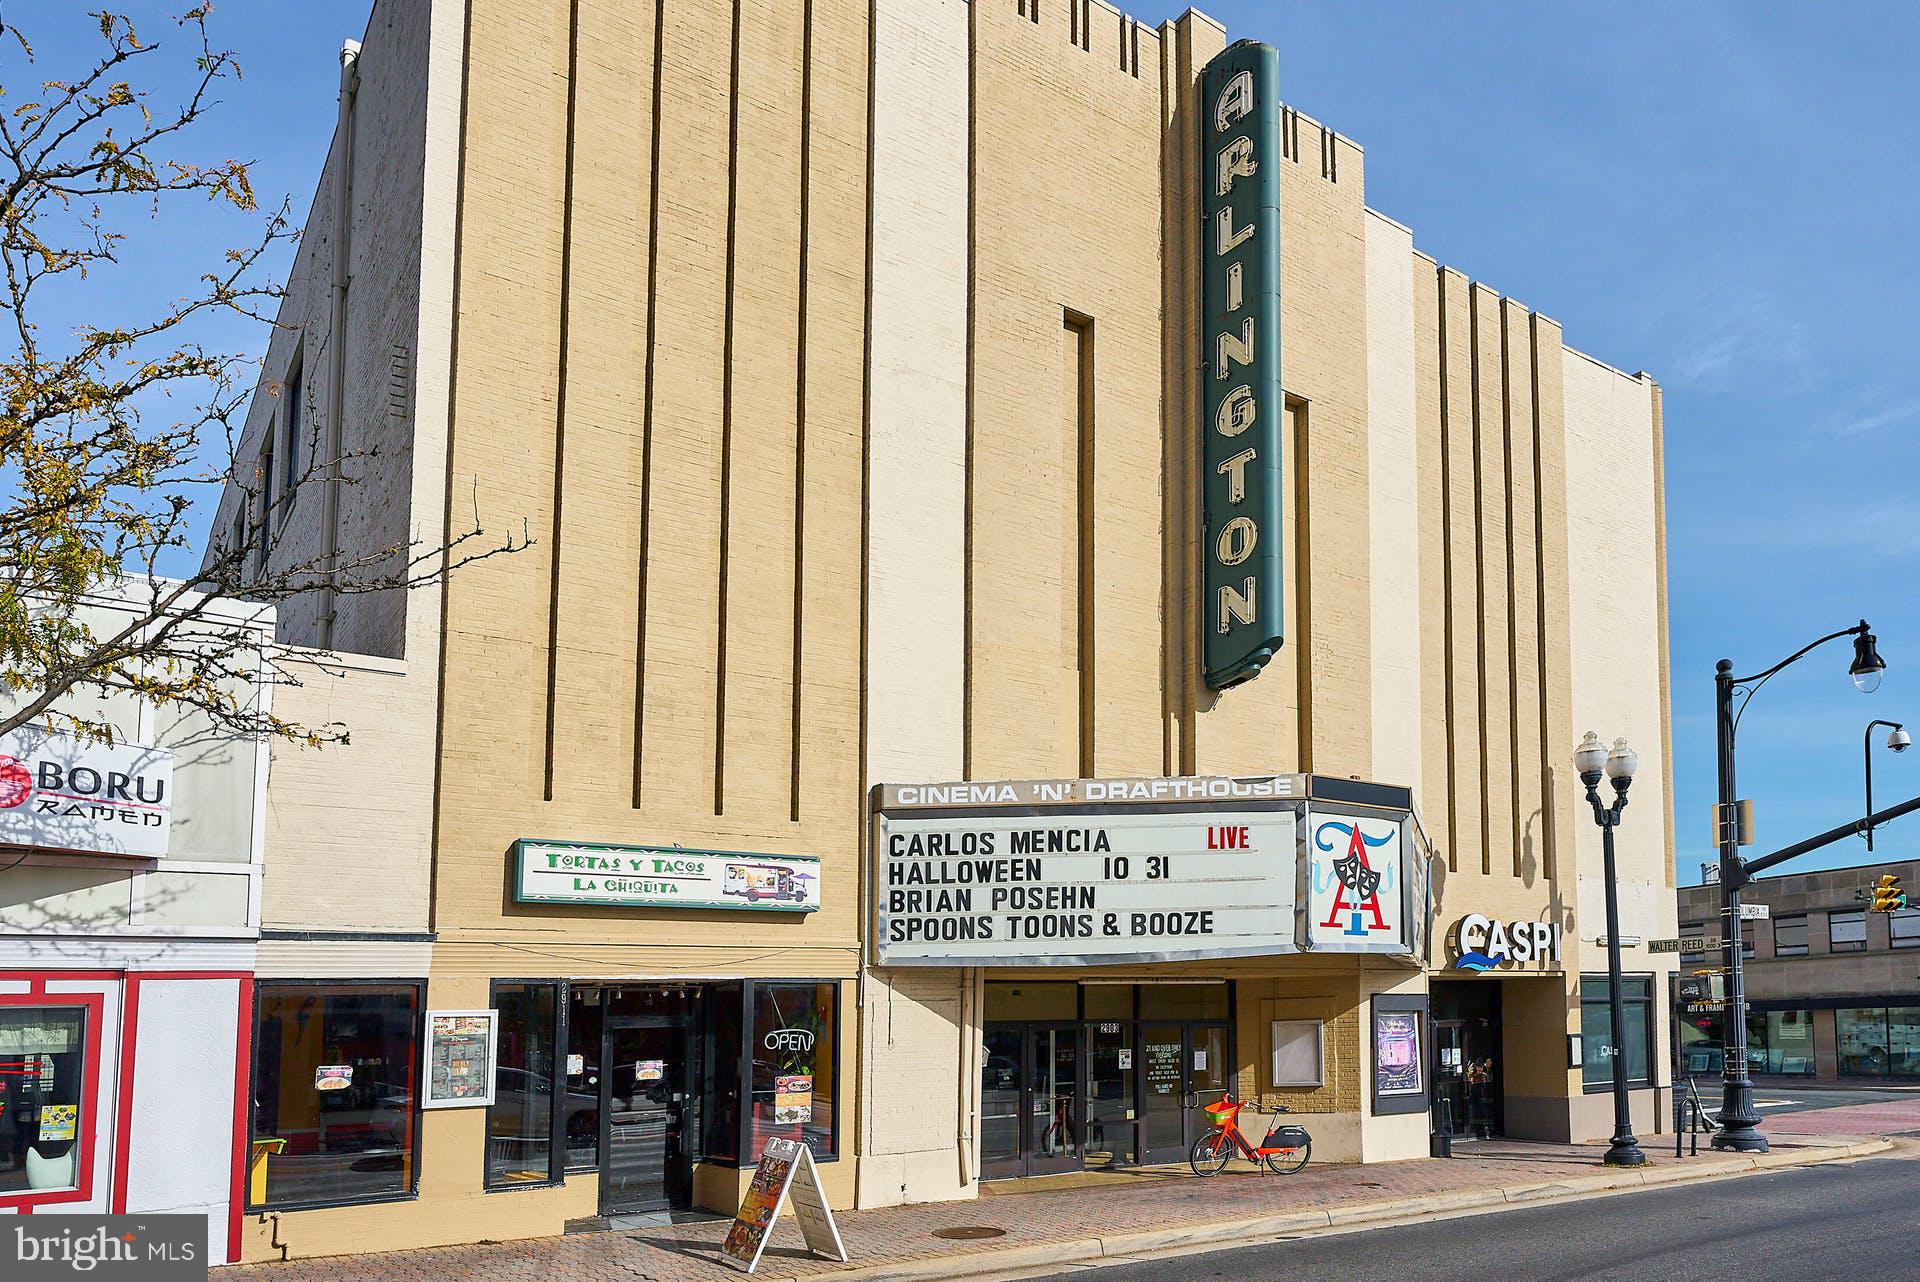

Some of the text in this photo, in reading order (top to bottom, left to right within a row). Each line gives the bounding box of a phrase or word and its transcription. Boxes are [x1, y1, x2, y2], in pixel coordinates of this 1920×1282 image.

[1214, 69, 1259, 635] ARLINGTON
[37, 760, 164, 804] BORU
[897, 784, 1019, 805] CINEMA
[1085, 778, 1292, 800] DRAFTHOUSE
[36, 799, 162, 828] RAMEN
[889, 826, 1250, 857] CARLOS MENCIA LIVE
[545, 853, 705, 875] TORTAS Y TACOS
[888, 855, 1169, 886] HALLOWEEN 10 31
[573, 877, 679, 894] LA CHIQUITA
[889, 886, 1096, 914] BRIAN POSEHN
[889, 910, 1214, 942] SPOONS TOONS & BOOZE
[1457, 912, 1561, 962] CASPI
[1650, 940, 1679, 952] WALTER
[1682, 939, 1704, 950] REED
[1687, 1004, 1699, 1013] ART
[764, 1032, 813, 1052] OPEN
